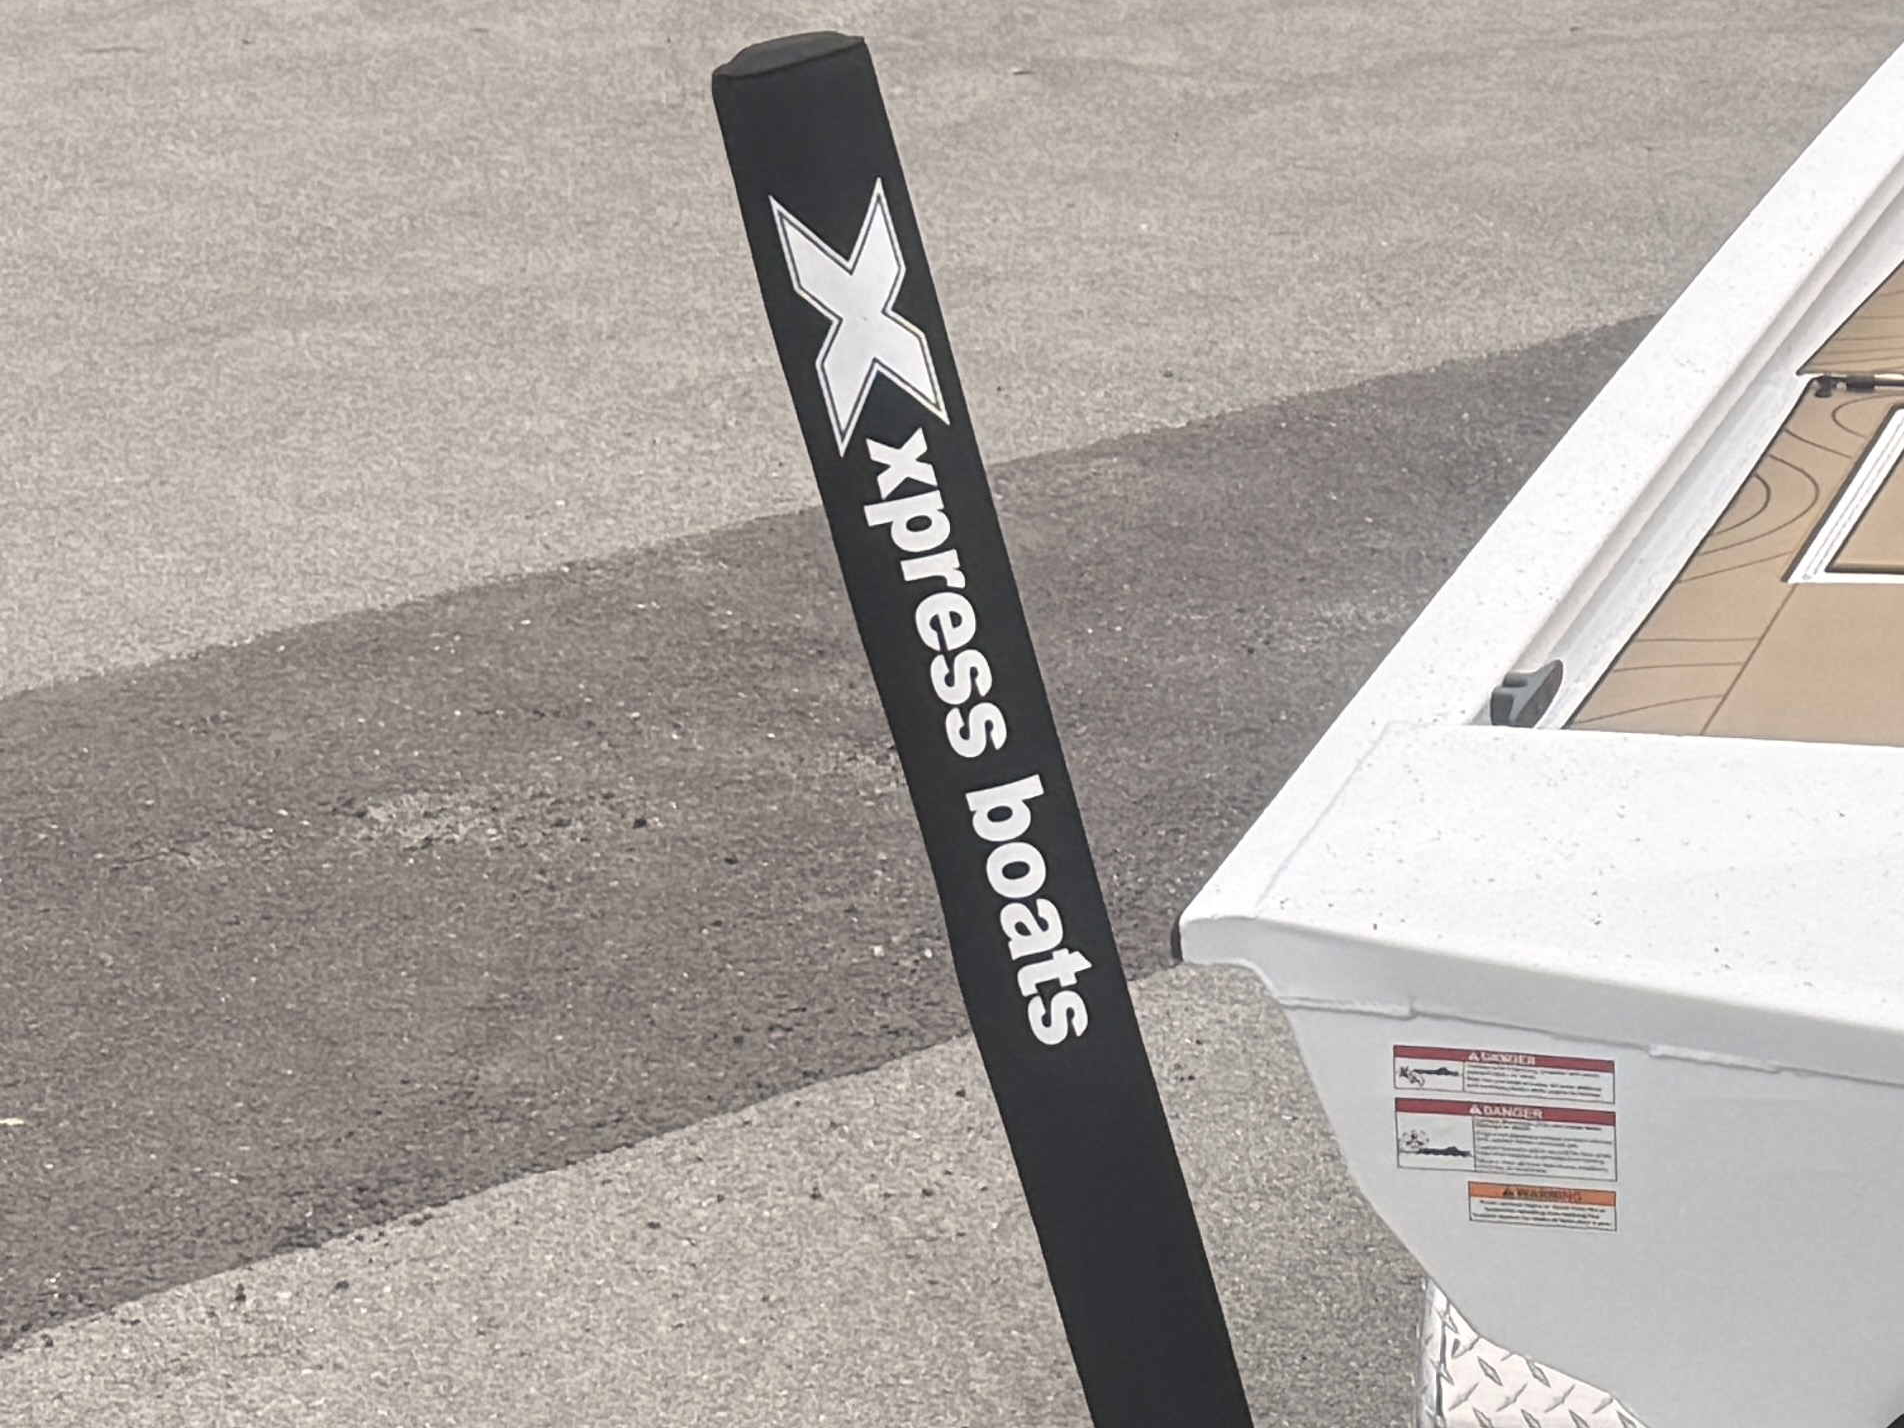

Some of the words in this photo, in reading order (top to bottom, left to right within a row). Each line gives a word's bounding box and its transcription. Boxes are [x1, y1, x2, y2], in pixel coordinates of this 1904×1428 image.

[863, 427, 1008, 758] xpress
[965, 775, 1089, 1046] boats
[1483, 1104, 1544, 1120] DANGER
